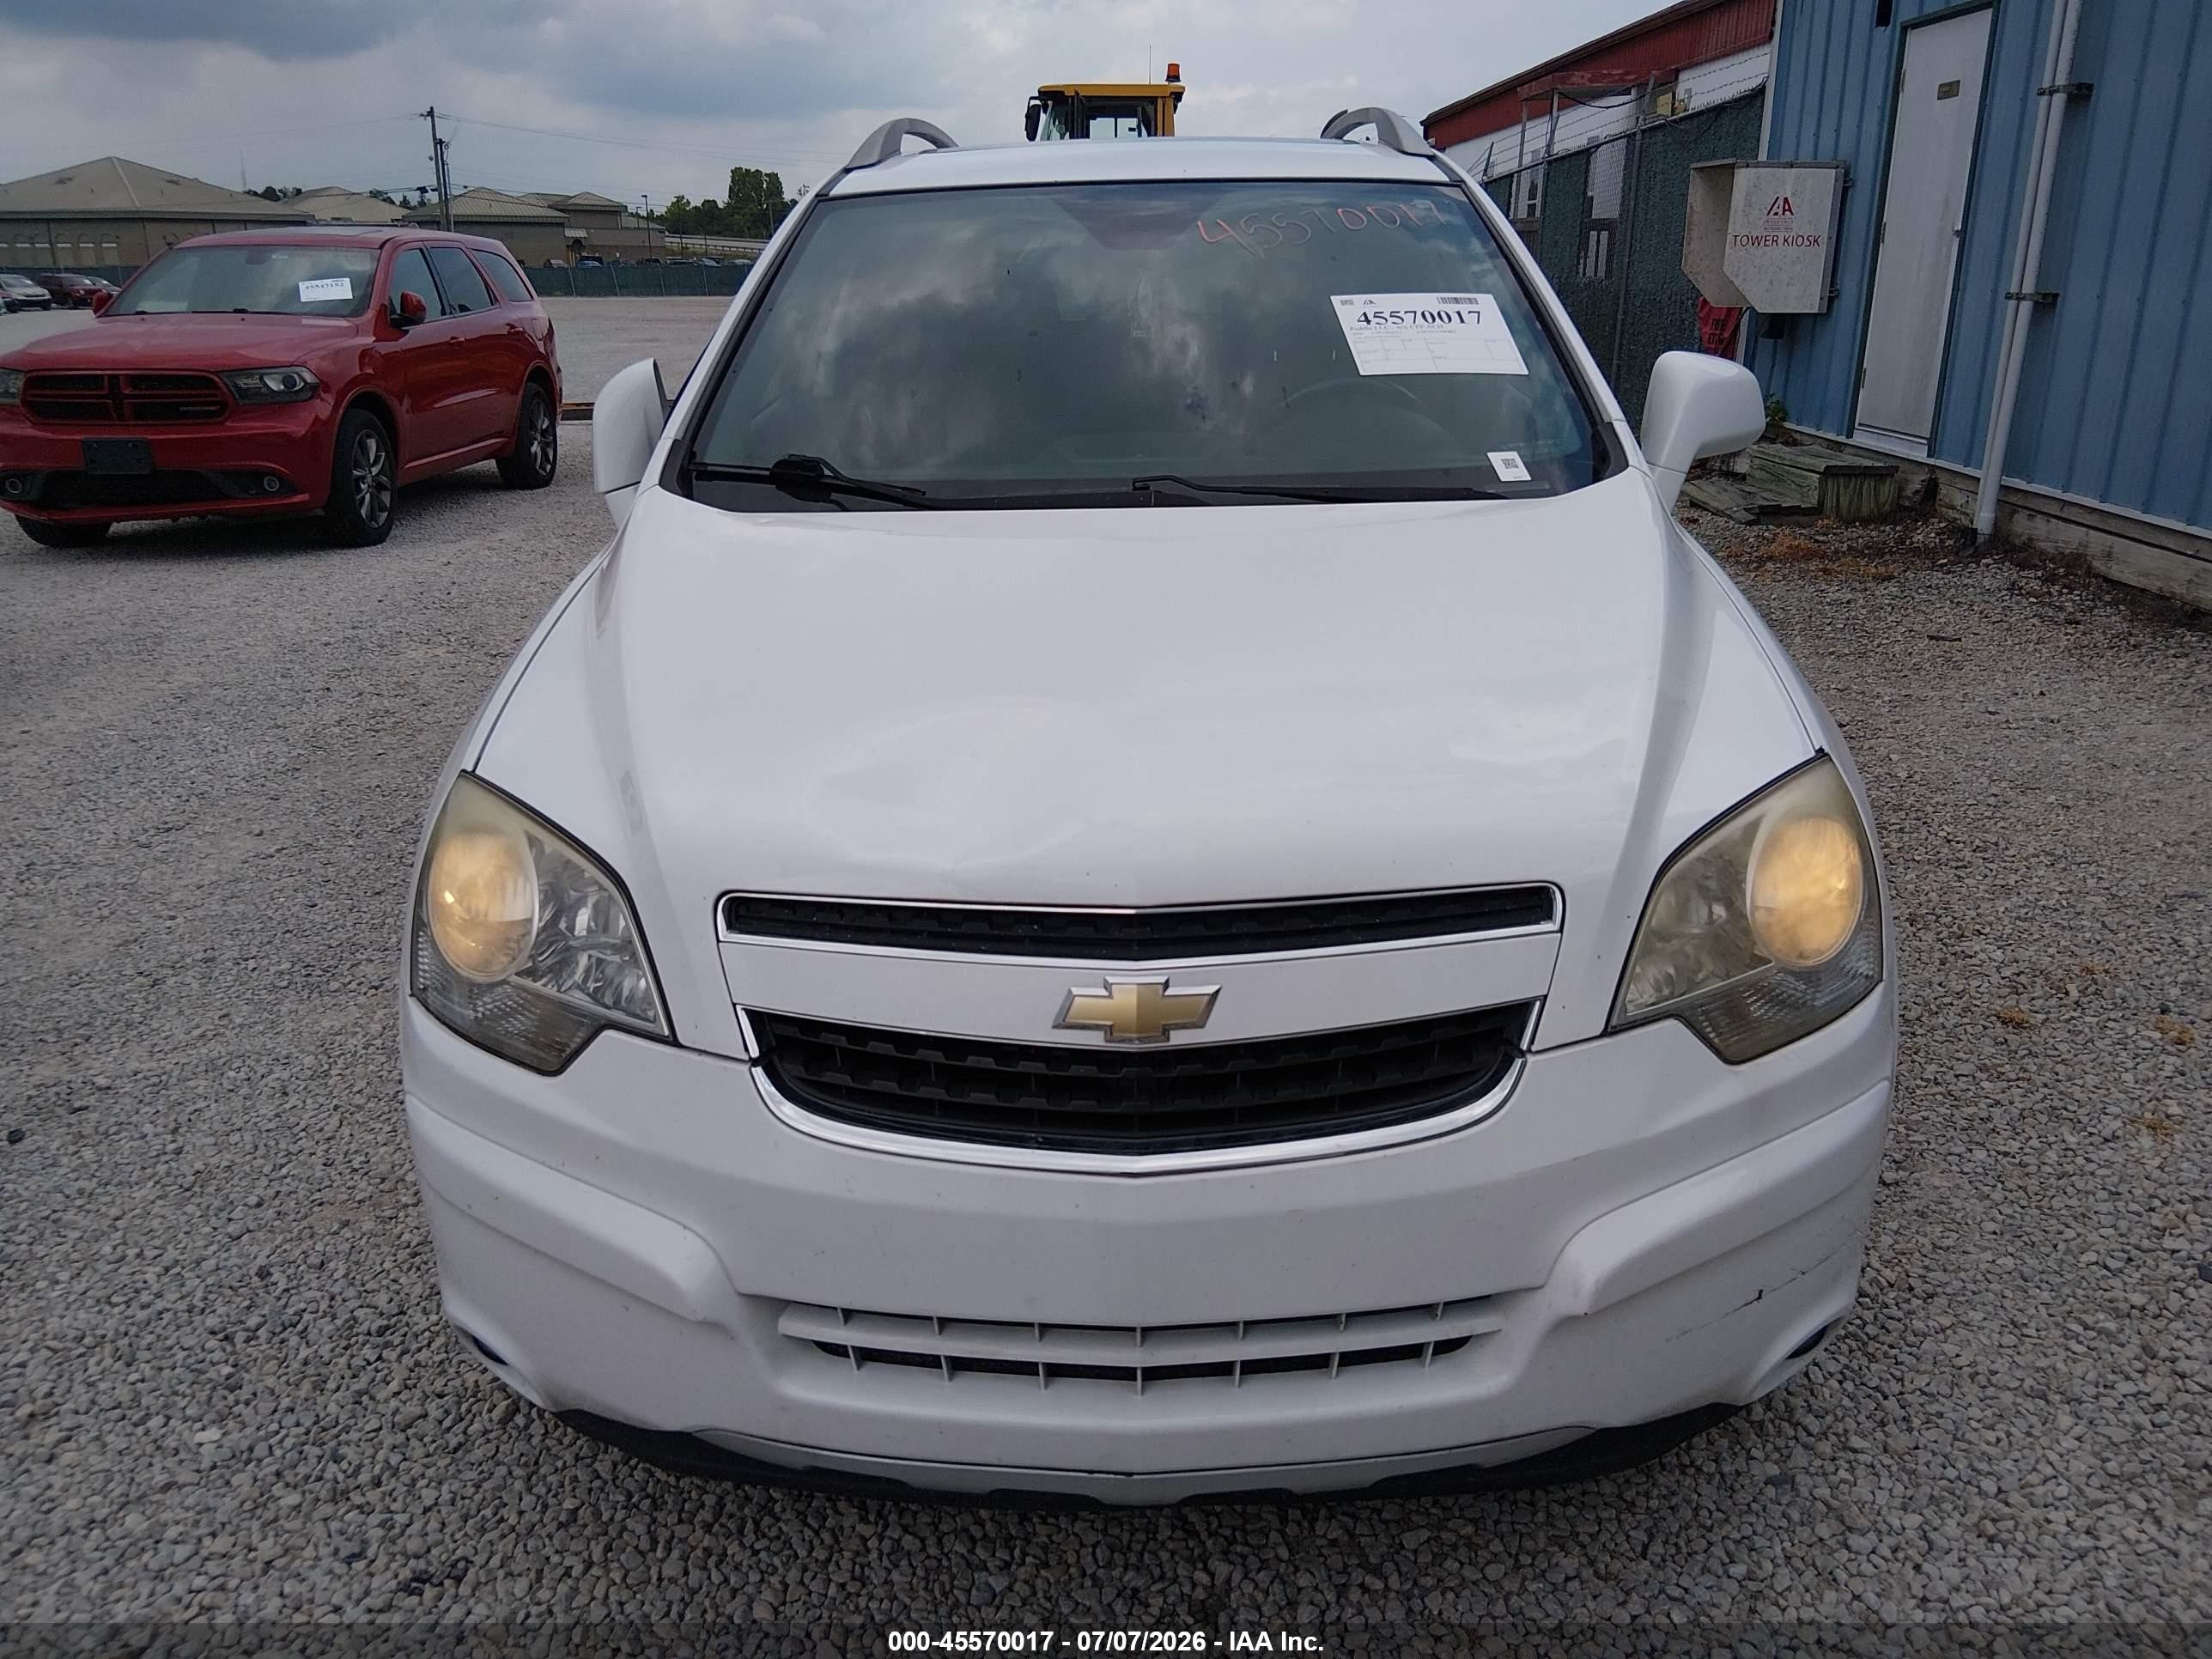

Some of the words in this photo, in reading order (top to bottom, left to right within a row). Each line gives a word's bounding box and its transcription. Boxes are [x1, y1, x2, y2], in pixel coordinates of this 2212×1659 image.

[1197, 200, 1447, 258] 45570017
[1732, 234, 1779, 247] TOWER
[1783, 234, 1821, 247] KIOSK
[1357, 310, 1481, 325] 45570017
